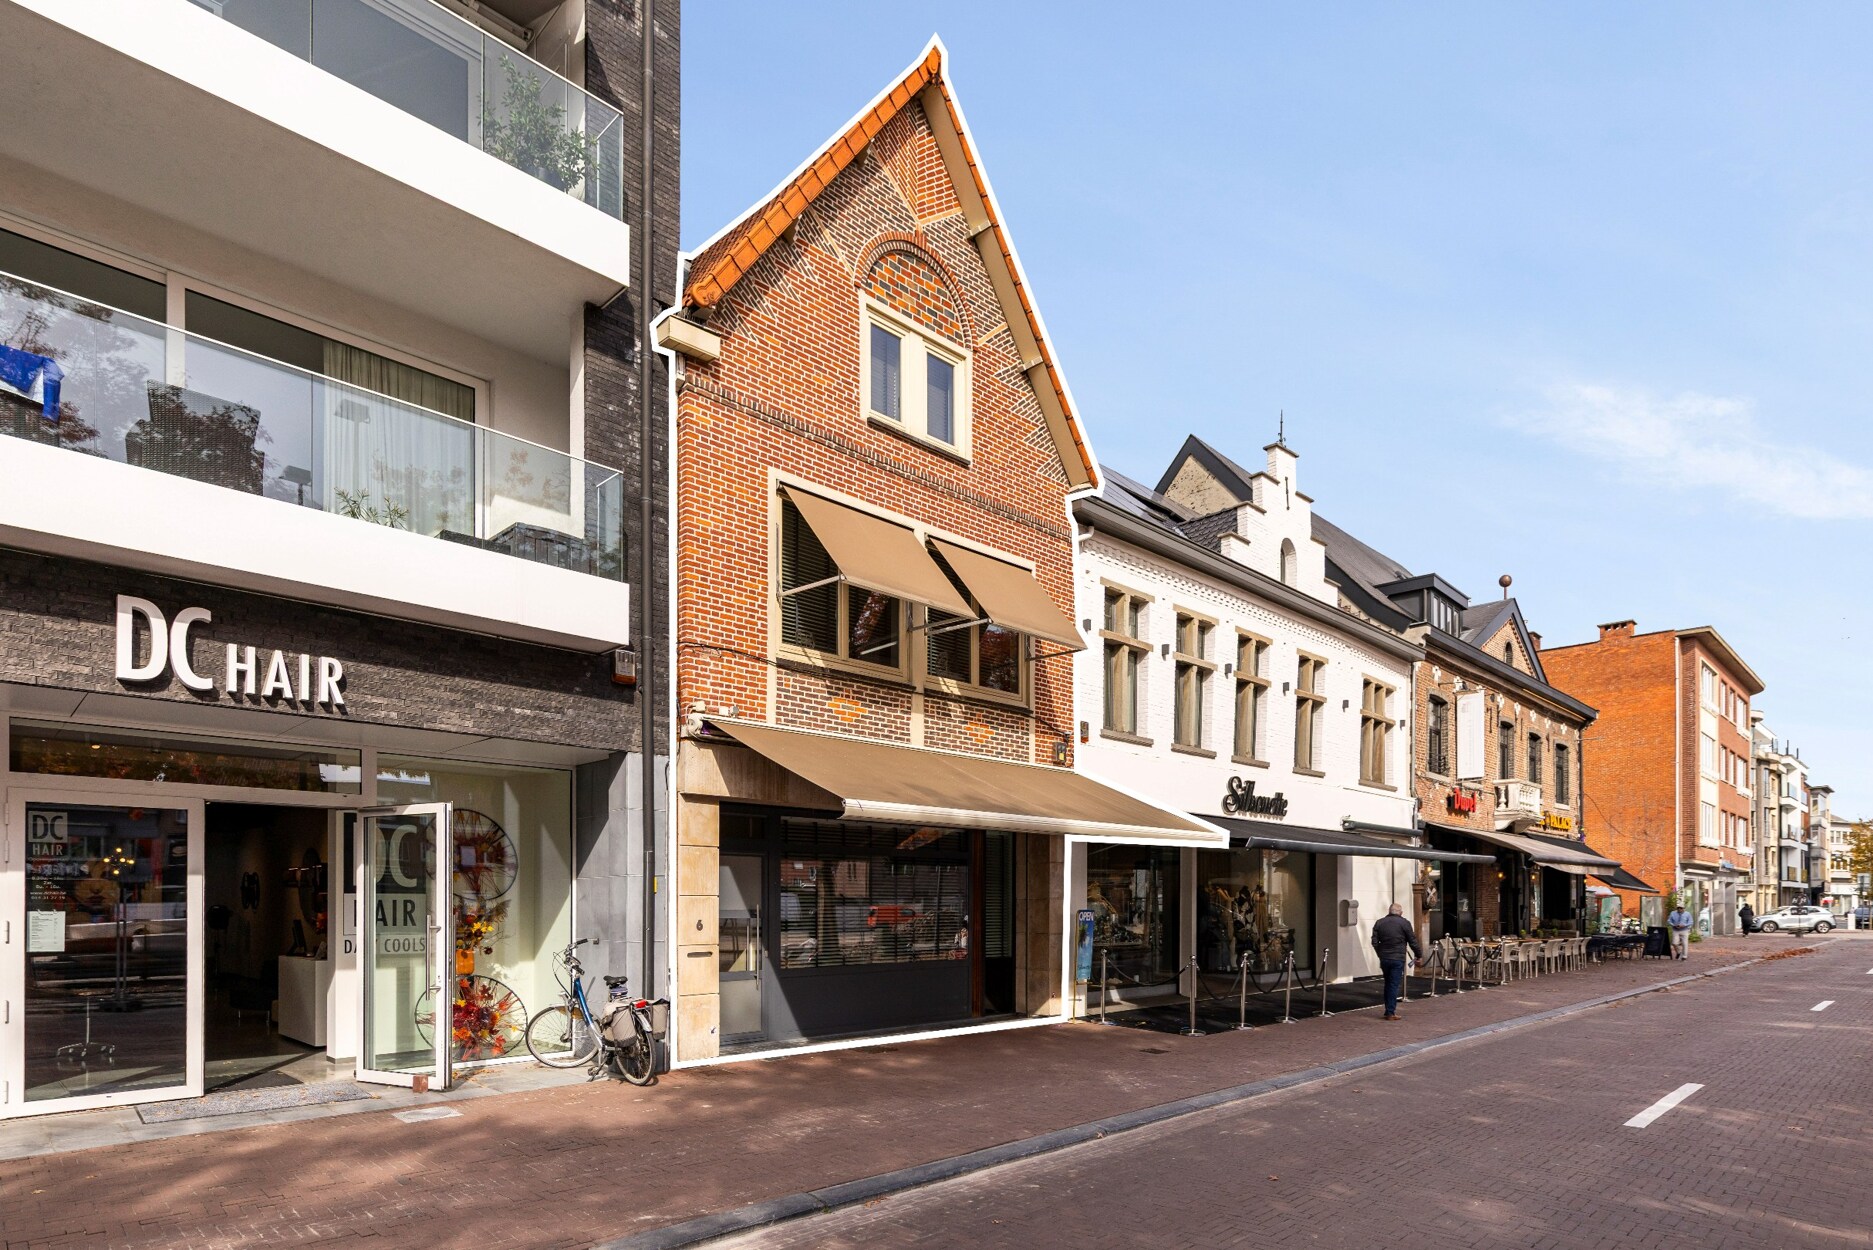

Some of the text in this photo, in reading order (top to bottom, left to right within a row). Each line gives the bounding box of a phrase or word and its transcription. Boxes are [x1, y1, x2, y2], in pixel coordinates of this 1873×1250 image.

[115, 594, 345, 705] DC HAIR
[32, 814, 64, 840] DC
[32, 843, 63, 856] HAIR
[354, 899, 417, 927] AIR
[1079, 911, 1094, 921] OPEN
[696, 919, 703, 931] 6
[384, 937, 426, 953] COOLS
